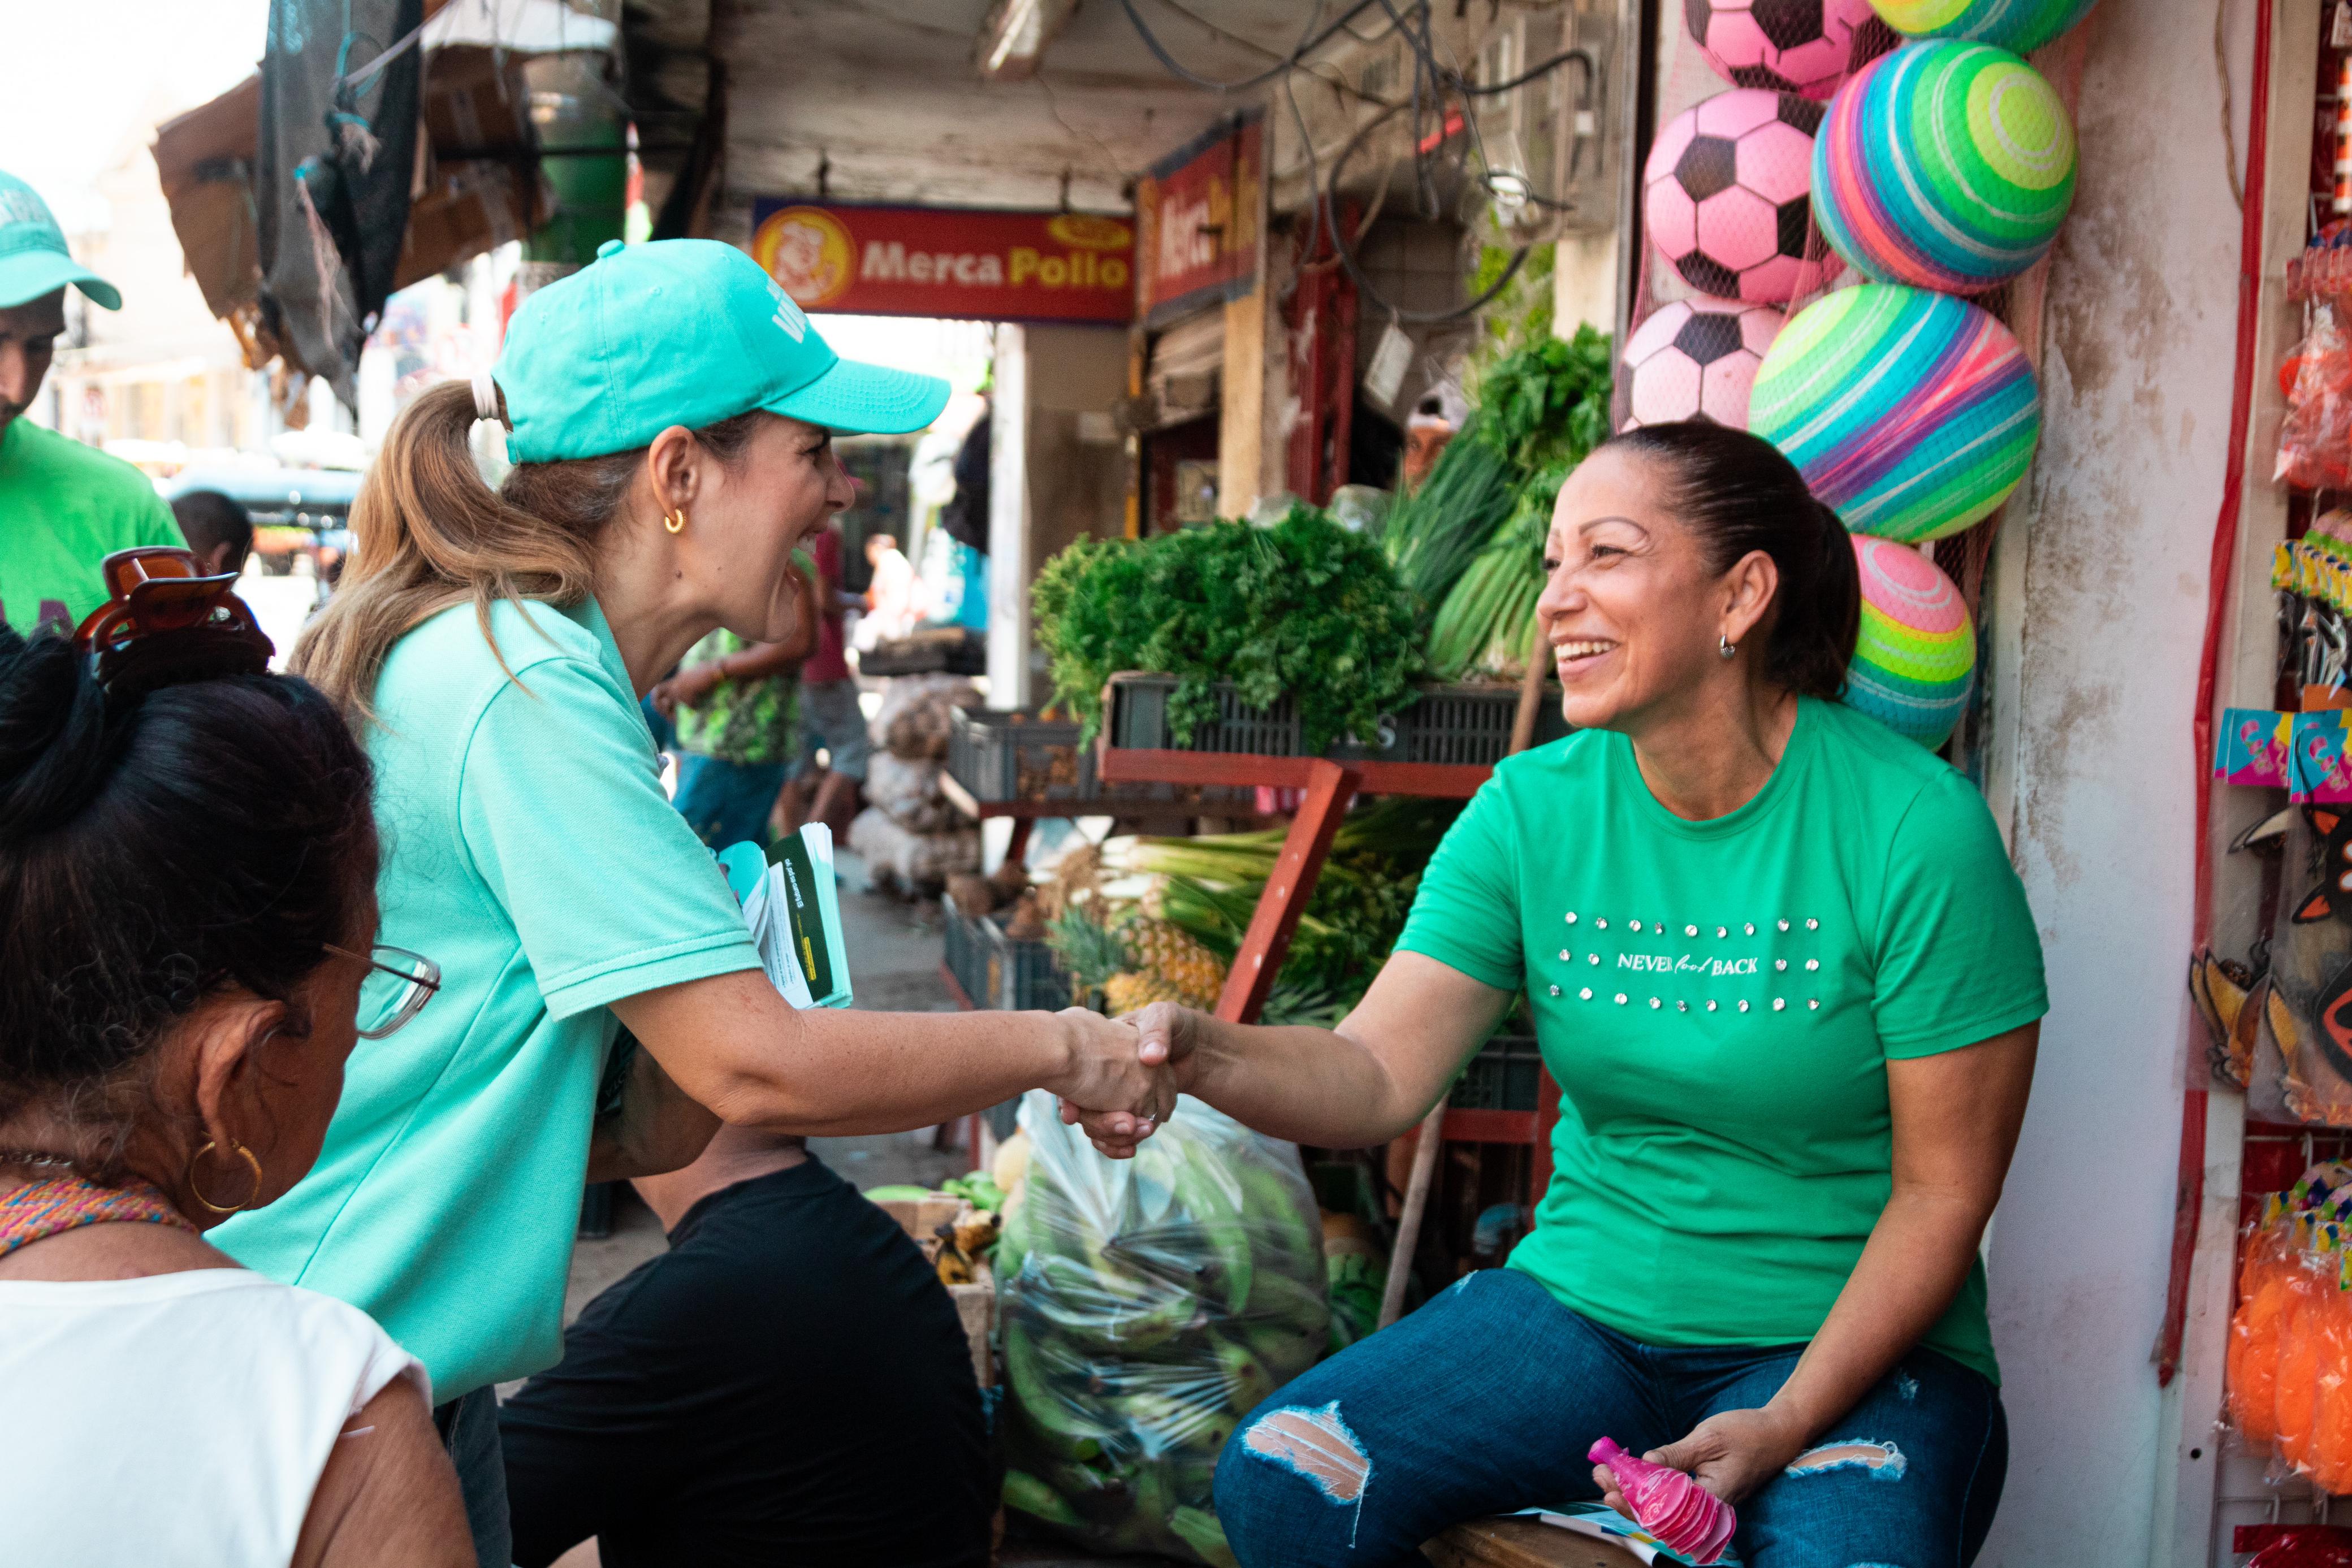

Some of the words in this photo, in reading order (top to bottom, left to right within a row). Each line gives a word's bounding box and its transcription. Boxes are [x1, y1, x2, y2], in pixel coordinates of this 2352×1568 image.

[862, 241, 1004, 285] Merca
[1009, 246, 1129, 288] Pollo
[793, 882, 802, 902] futuro
[1617, 952, 1673, 972] NEVER
[1711, 957, 1758, 977] BACK
